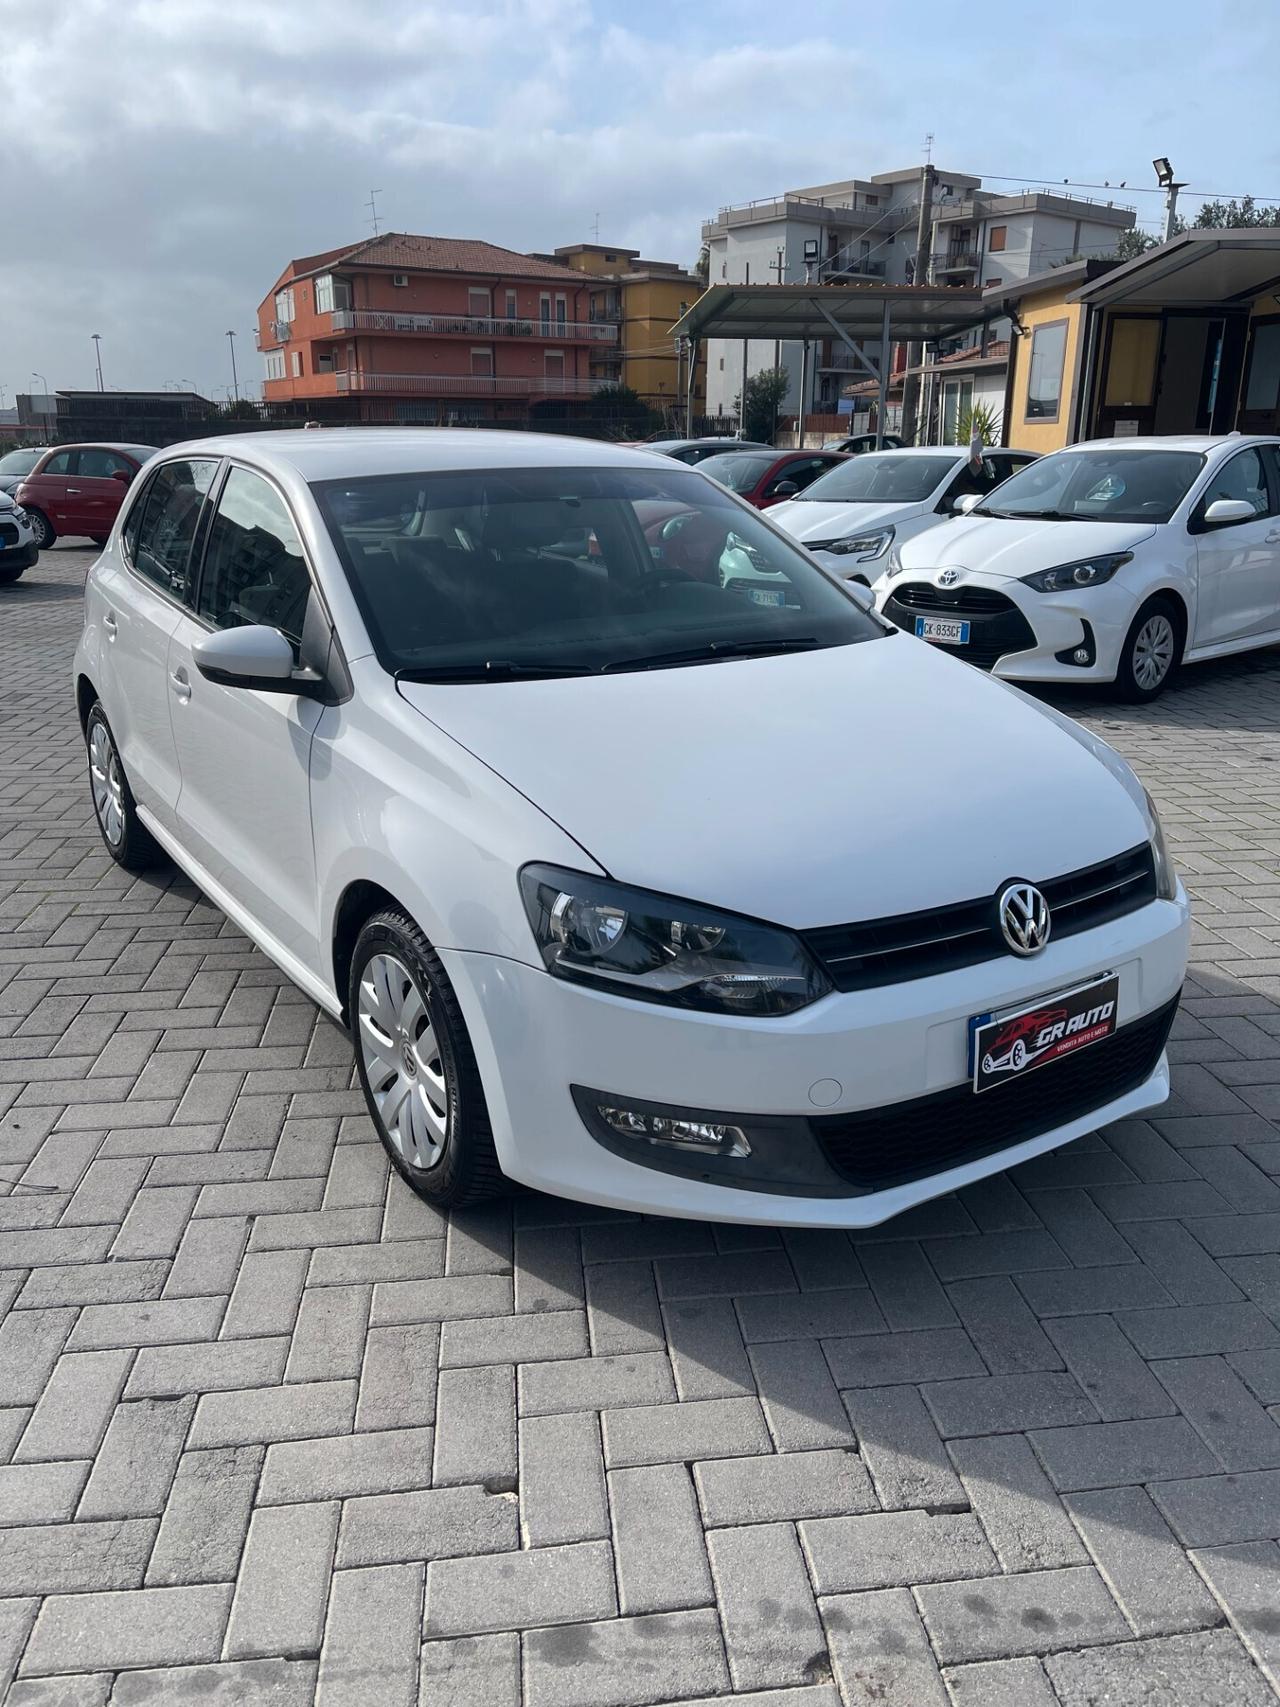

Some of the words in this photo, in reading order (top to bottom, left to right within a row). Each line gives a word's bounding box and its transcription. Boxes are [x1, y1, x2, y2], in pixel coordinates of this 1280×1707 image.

[1034, 1021, 1065, 1047] GR
[1066, 1001, 1115, 1035] AUTO
[1078, 1033, 1091, 1043] AUTO
